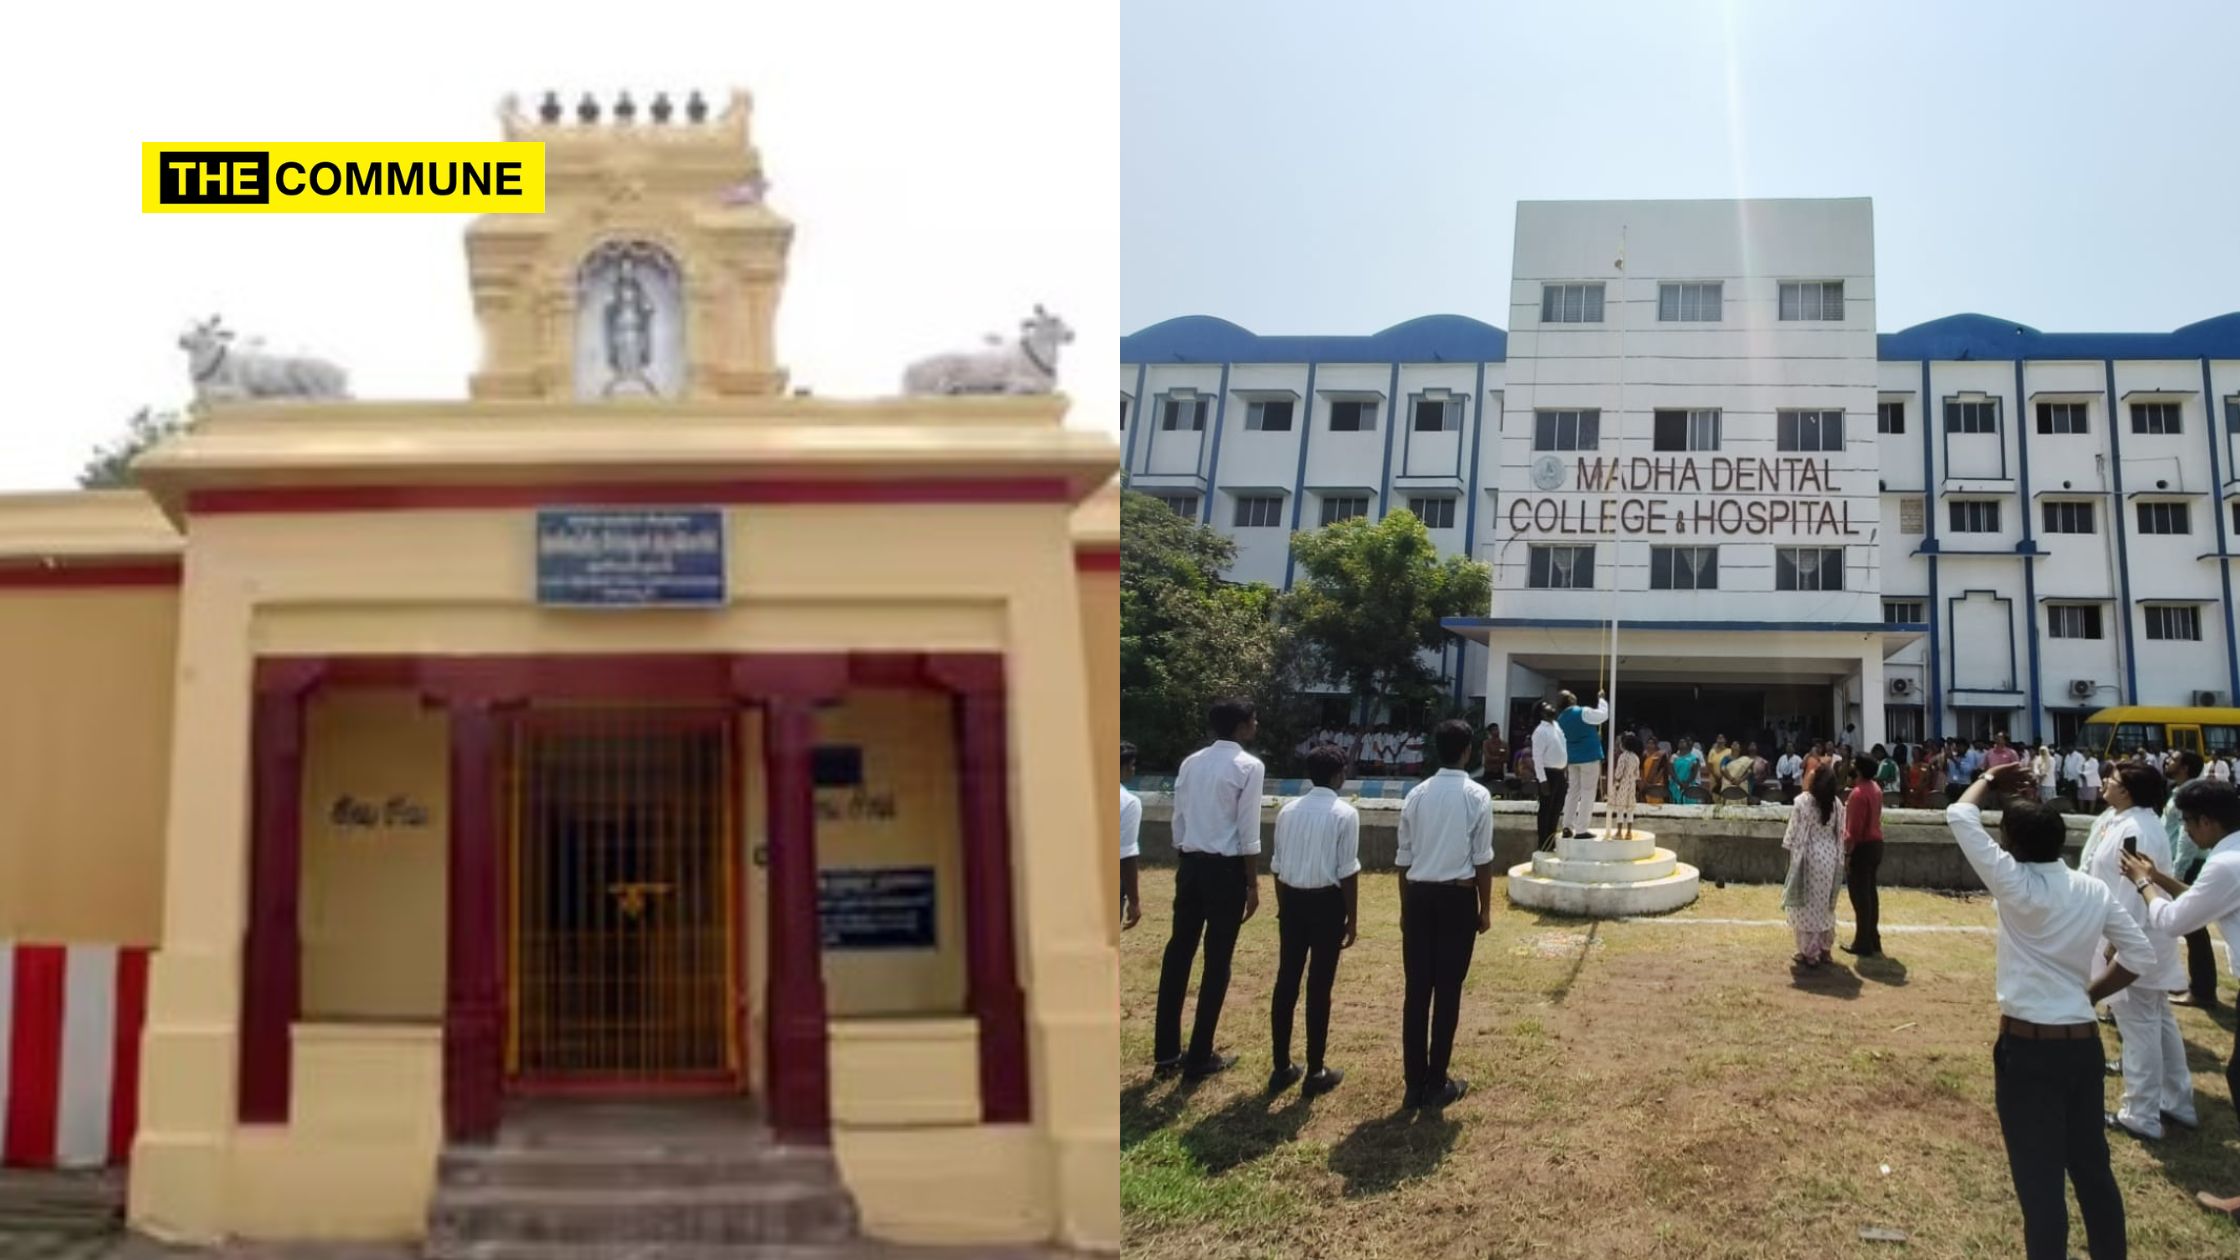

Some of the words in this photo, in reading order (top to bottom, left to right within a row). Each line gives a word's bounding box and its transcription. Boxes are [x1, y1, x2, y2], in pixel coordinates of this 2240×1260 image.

[1577, 457, 1700, 491] MADHA
[1711, 457, 1842, 492] DENTAL
[1509, 498, 1668, 534] COLLEGE
[1676, 510, 1685, 534] &
[1694, 499, 1860, 535] HOSPITAL
